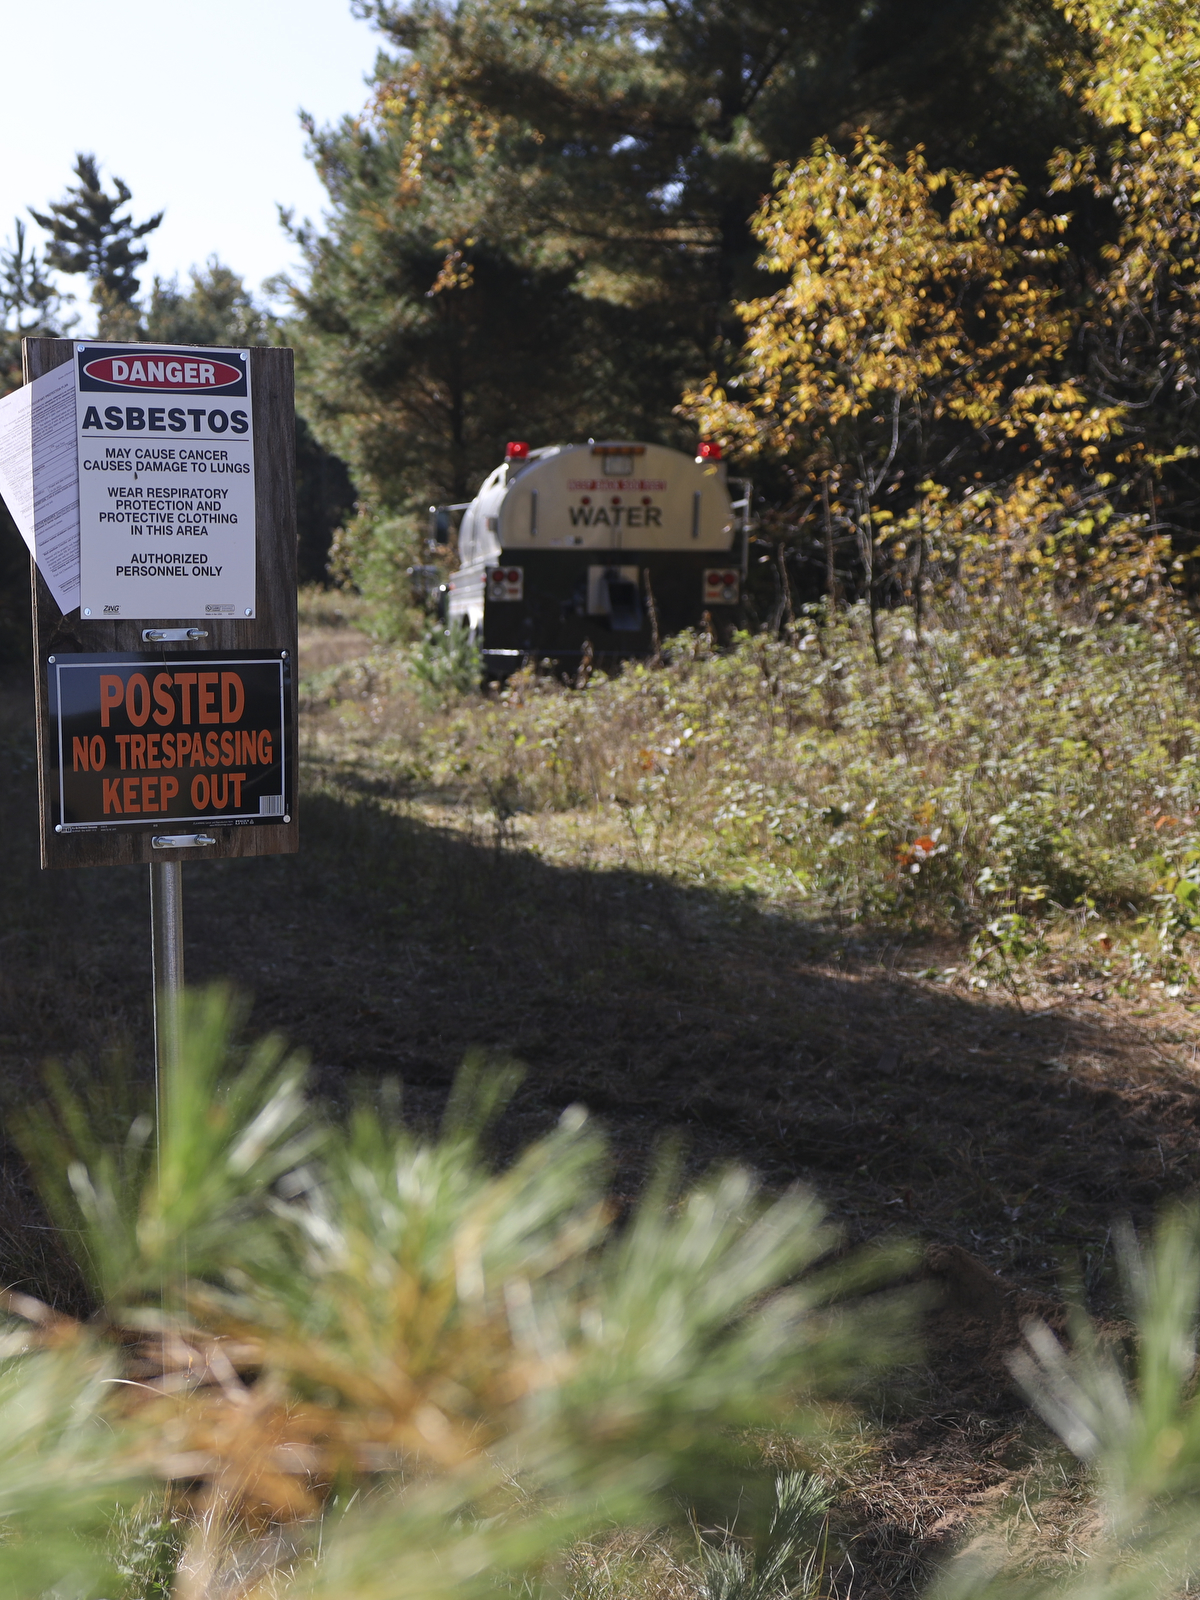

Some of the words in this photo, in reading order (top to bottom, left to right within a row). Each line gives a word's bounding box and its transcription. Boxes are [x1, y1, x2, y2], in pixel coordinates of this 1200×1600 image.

[111, 360, 216, 384] DANGER
[82, 406, 249, 433] ASBESTOS
[105, 448, 132, 459] MAY
[135, 449, 175, 460] CAUSE
[178, 450, 228, 461] CANCER
[83, 460, 133, 471] CAUSES
[136, 461, 188, 472] DAMAGE
[191, 462, 207, 472] TO
[210, 462, 250, 474] LUNGS
[107, 487, 143, 498] WEAR
[146, 487, 228, 499] RESPIRATORY
[116, 500, 193, 511] PROTECTION
[196, 501, 221, 511] AND
[99, 512, 174, 523] PROTECTIVE
[177, 513, 238, 524] CLOTHING
[569, 505, 663, 527] WATER
[131, 525, 143, 535] IN
[146, 525, 173, 536] THIS
[176, 525, 208, 536] AREA
[131, 553, 208, 564] AUTHORIZED
[116, 566, 189, 577] PERSONNEL
[192, 566, 223, 577] ONLY
[100, 672, 245, 727] POSTED
[73, 735, 106, 772] NO
[115, 729, 273, 770] TRESPASSING
[102, 776, 179, 814] KEEP
[190, 773, 246, 810] OUT
